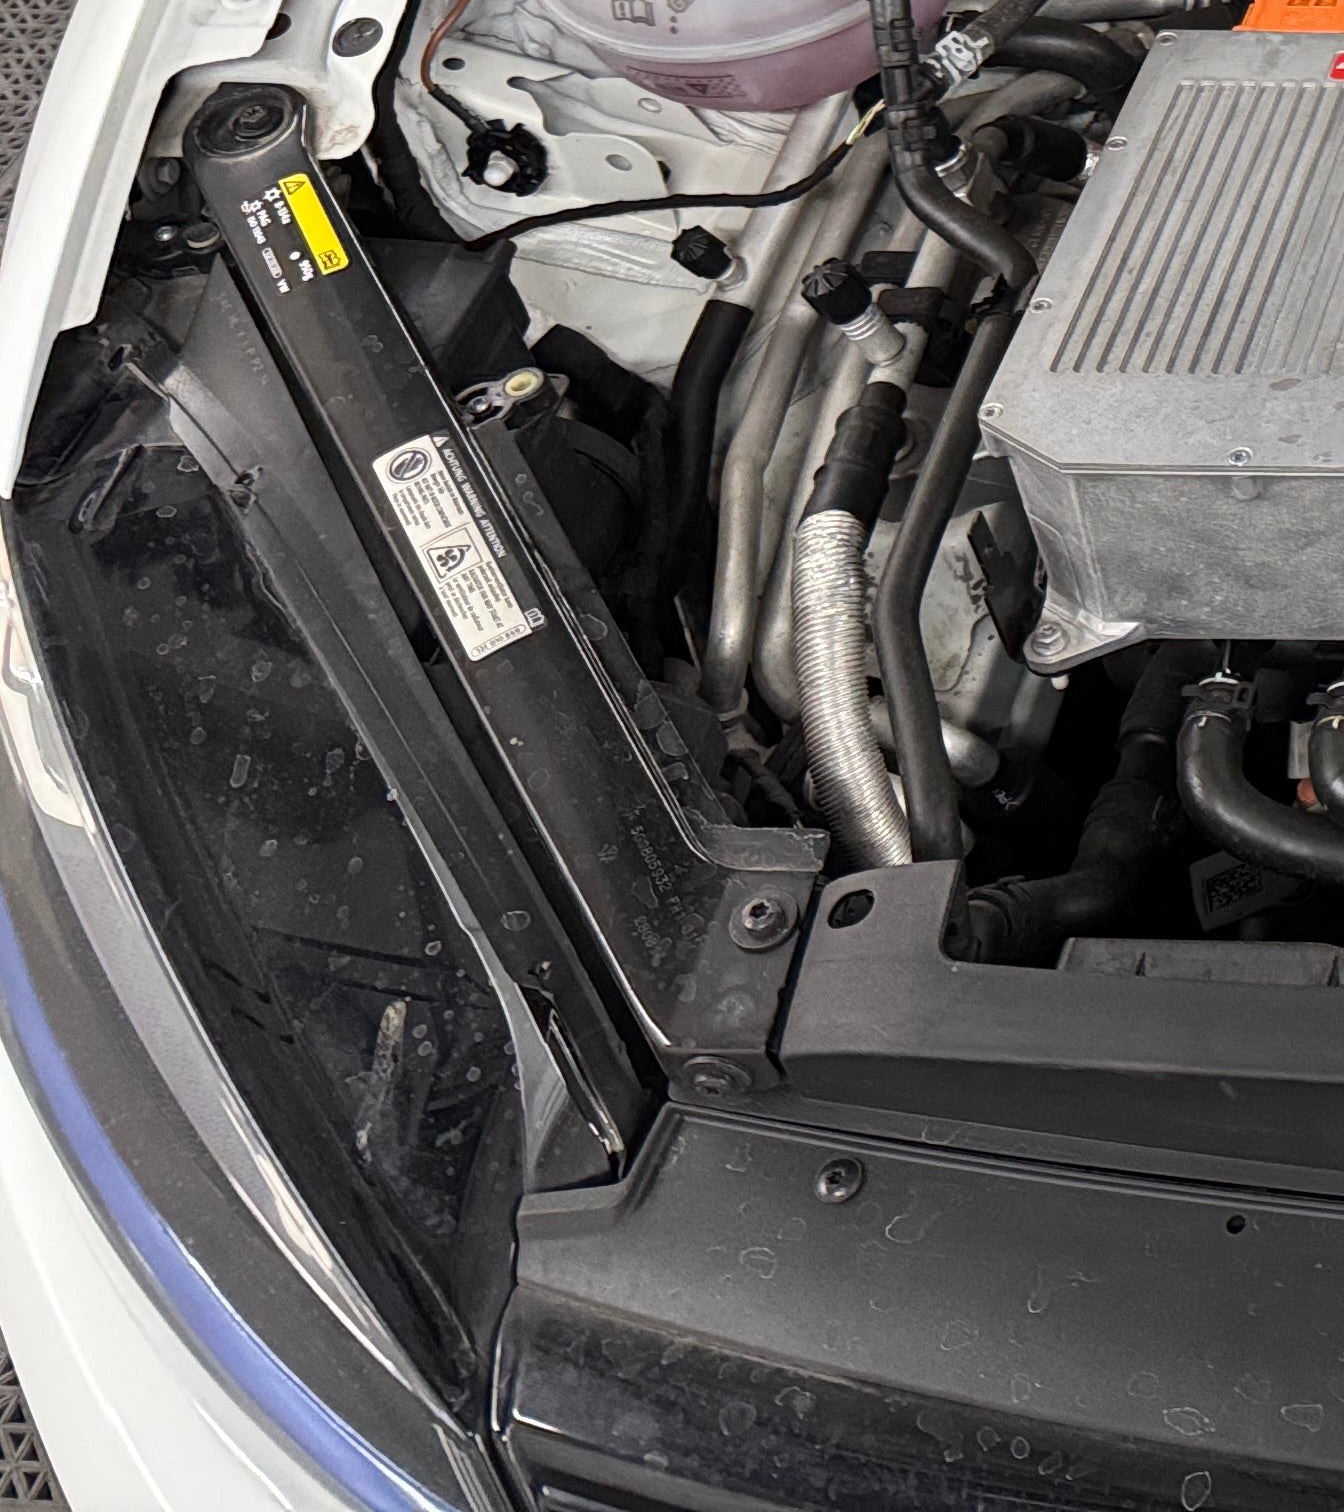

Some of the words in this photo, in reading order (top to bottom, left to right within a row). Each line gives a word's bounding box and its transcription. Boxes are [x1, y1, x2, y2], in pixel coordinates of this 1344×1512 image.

[443, 448, 468, 483] ACHTUNG
[461, 481, 487, 518] WARNING
[479, 519, 508, 559] ATTENTION
